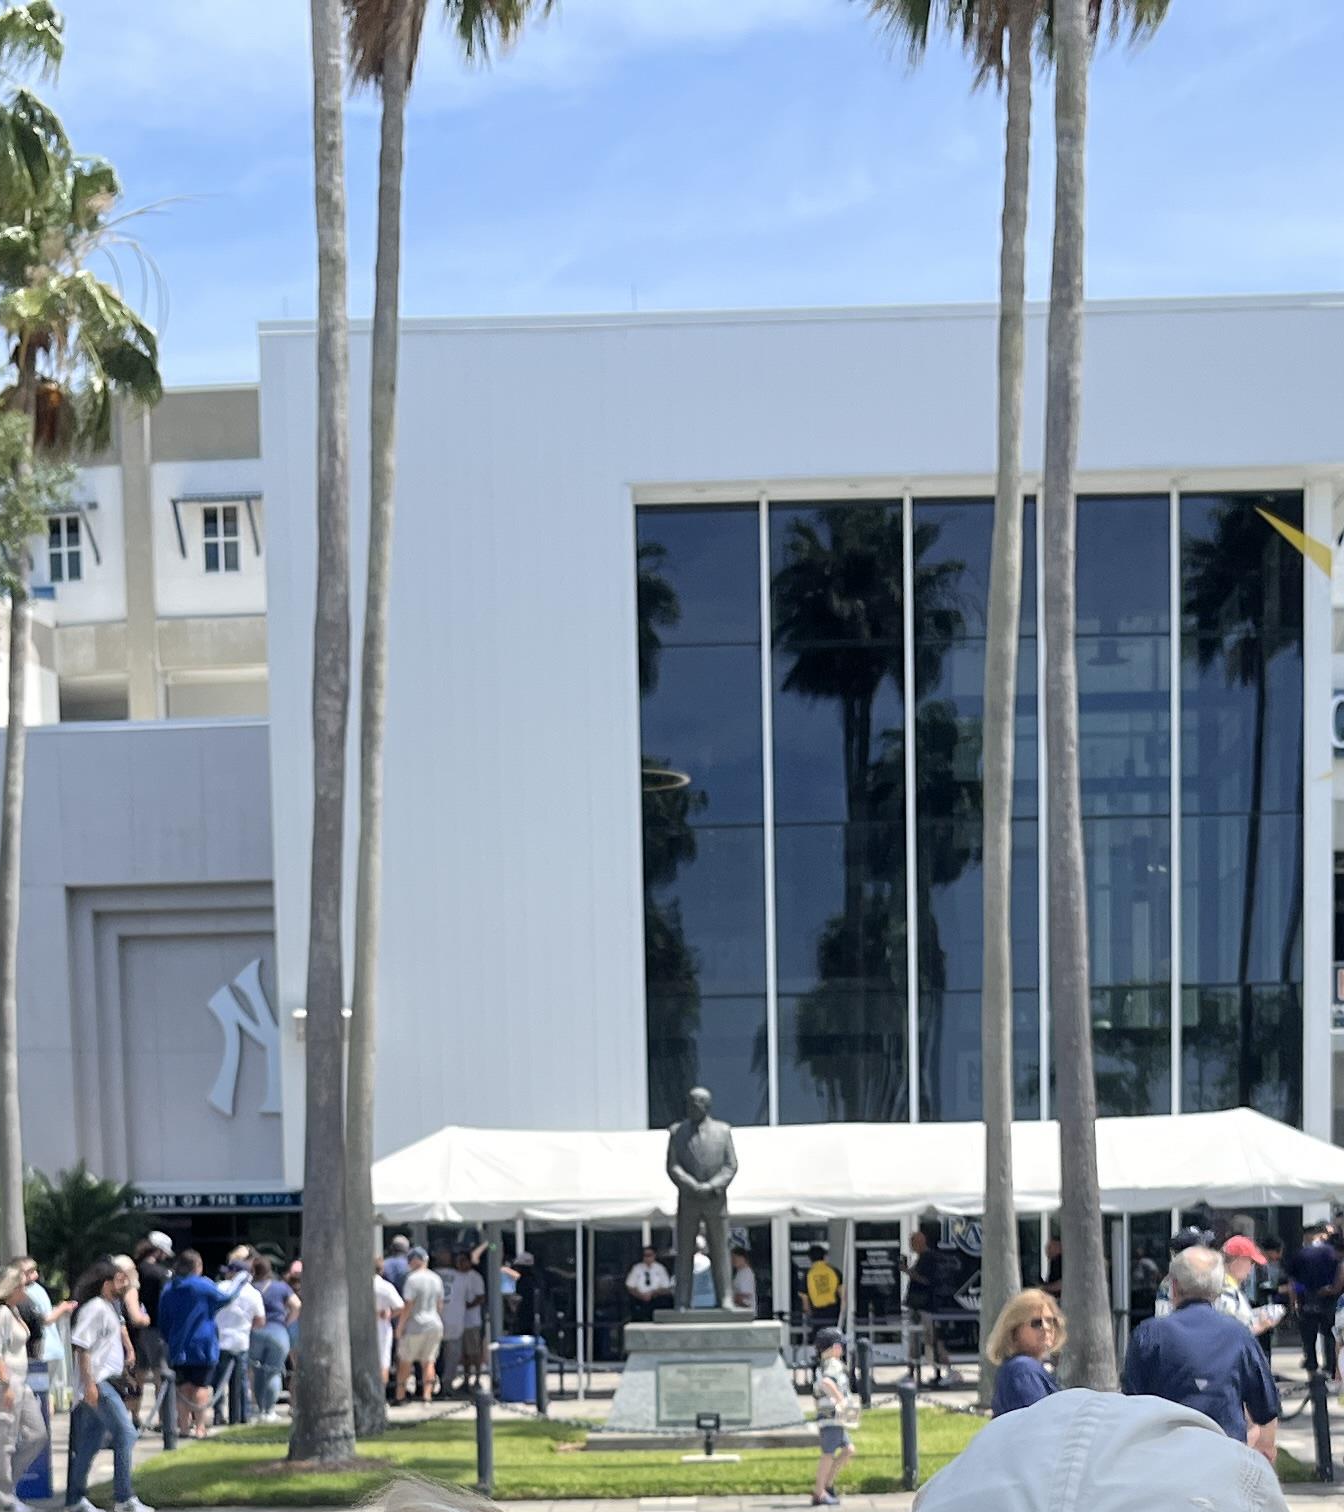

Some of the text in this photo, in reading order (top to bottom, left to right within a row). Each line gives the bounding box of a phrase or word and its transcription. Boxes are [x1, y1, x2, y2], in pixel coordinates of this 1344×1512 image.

[133, 1194, 176, 1208] HOME
[181, 1194, 203, 1207] OF
[208, 1194, 237, 1207] THE
